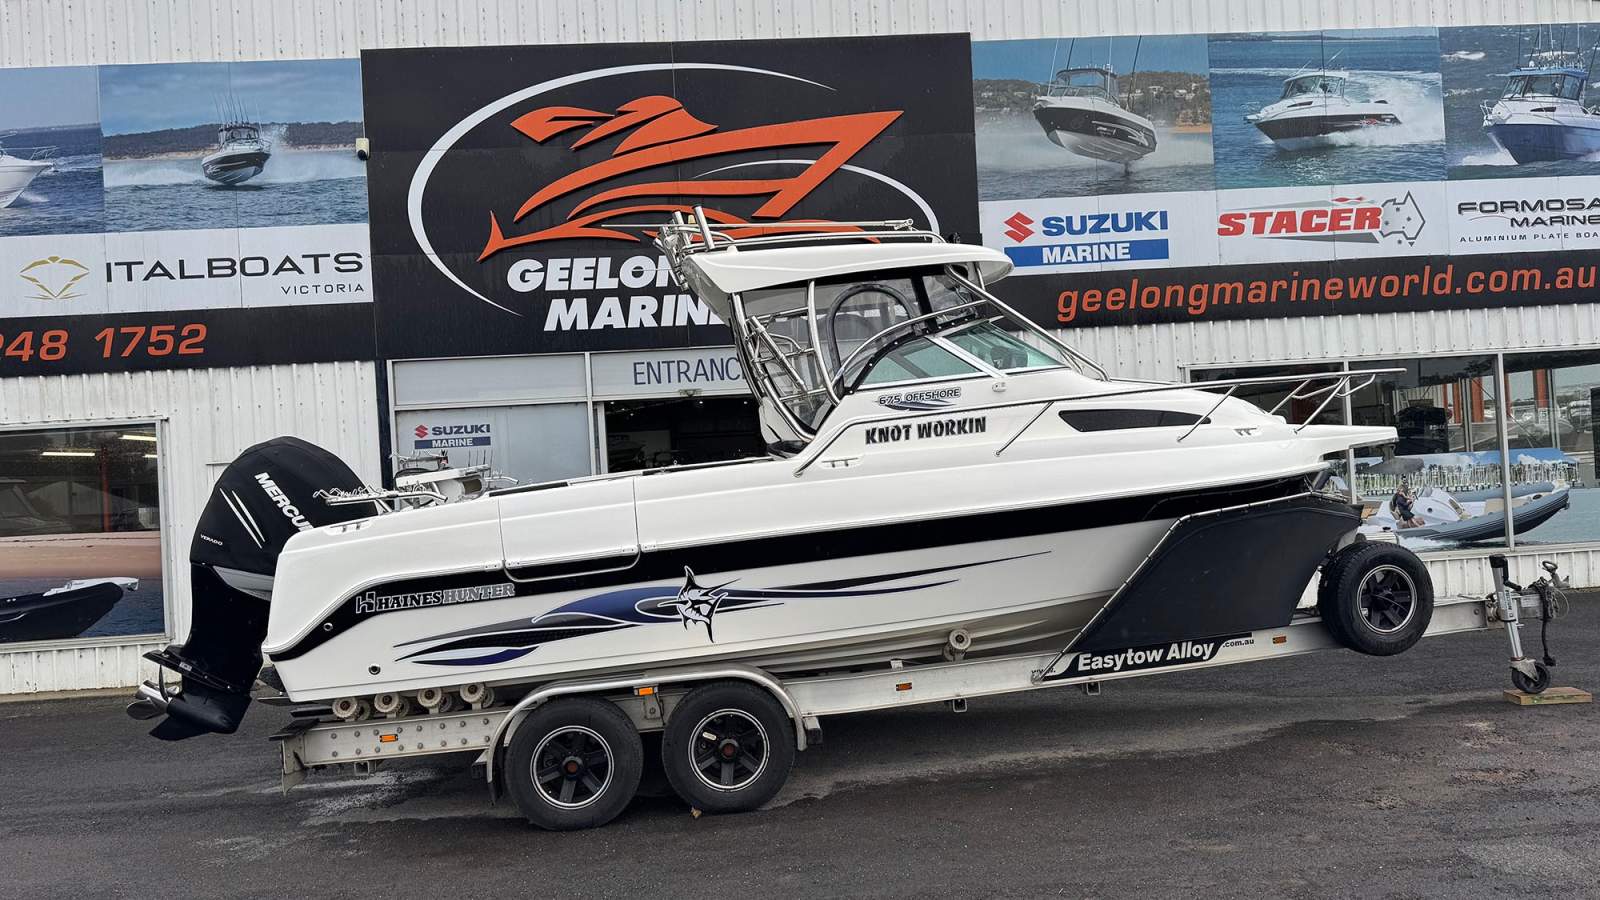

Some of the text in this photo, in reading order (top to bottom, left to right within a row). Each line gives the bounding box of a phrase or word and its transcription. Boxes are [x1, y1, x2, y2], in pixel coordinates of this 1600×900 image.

[1457, 197, 1600, 215] FORMOSA
[1041, 210, 1169, 236] SUZUKI
[1217, 206, 1383, 237] STACER
[1509, 214, 1600, 228] MARINE
[1459, 233, 1528, 243] ALUMINIUM
[1533, 231, 1570, 241] PLATE
[1042, 242, 1131, 264] MARINE
[105, 252, 364, 283] ITALBOATS
[506, 255, 681, 293] GEELON
[280, 283, 364, 296] VICTORIA
[1056, 264, 1598, 322] geelongmarineworld.com.au
[543, 294, 726, 332] MARIN
[94, 323, 208, 358] 1752
[632, 356, 745, 386] ENTRANC
[879, 386, 961, 406] 675 OFFSHORE
[431, 423, 491, 436] SUZUKI
[865, 416, 987, 445] KNOT WORKIN
[431, 438, 474, 449] MARINE
[254, 471, 314, 533] MERCU
[1077, 641, 1215, 671] Easytow Alloy
[1222, 638, 1255, 648] .com.au
